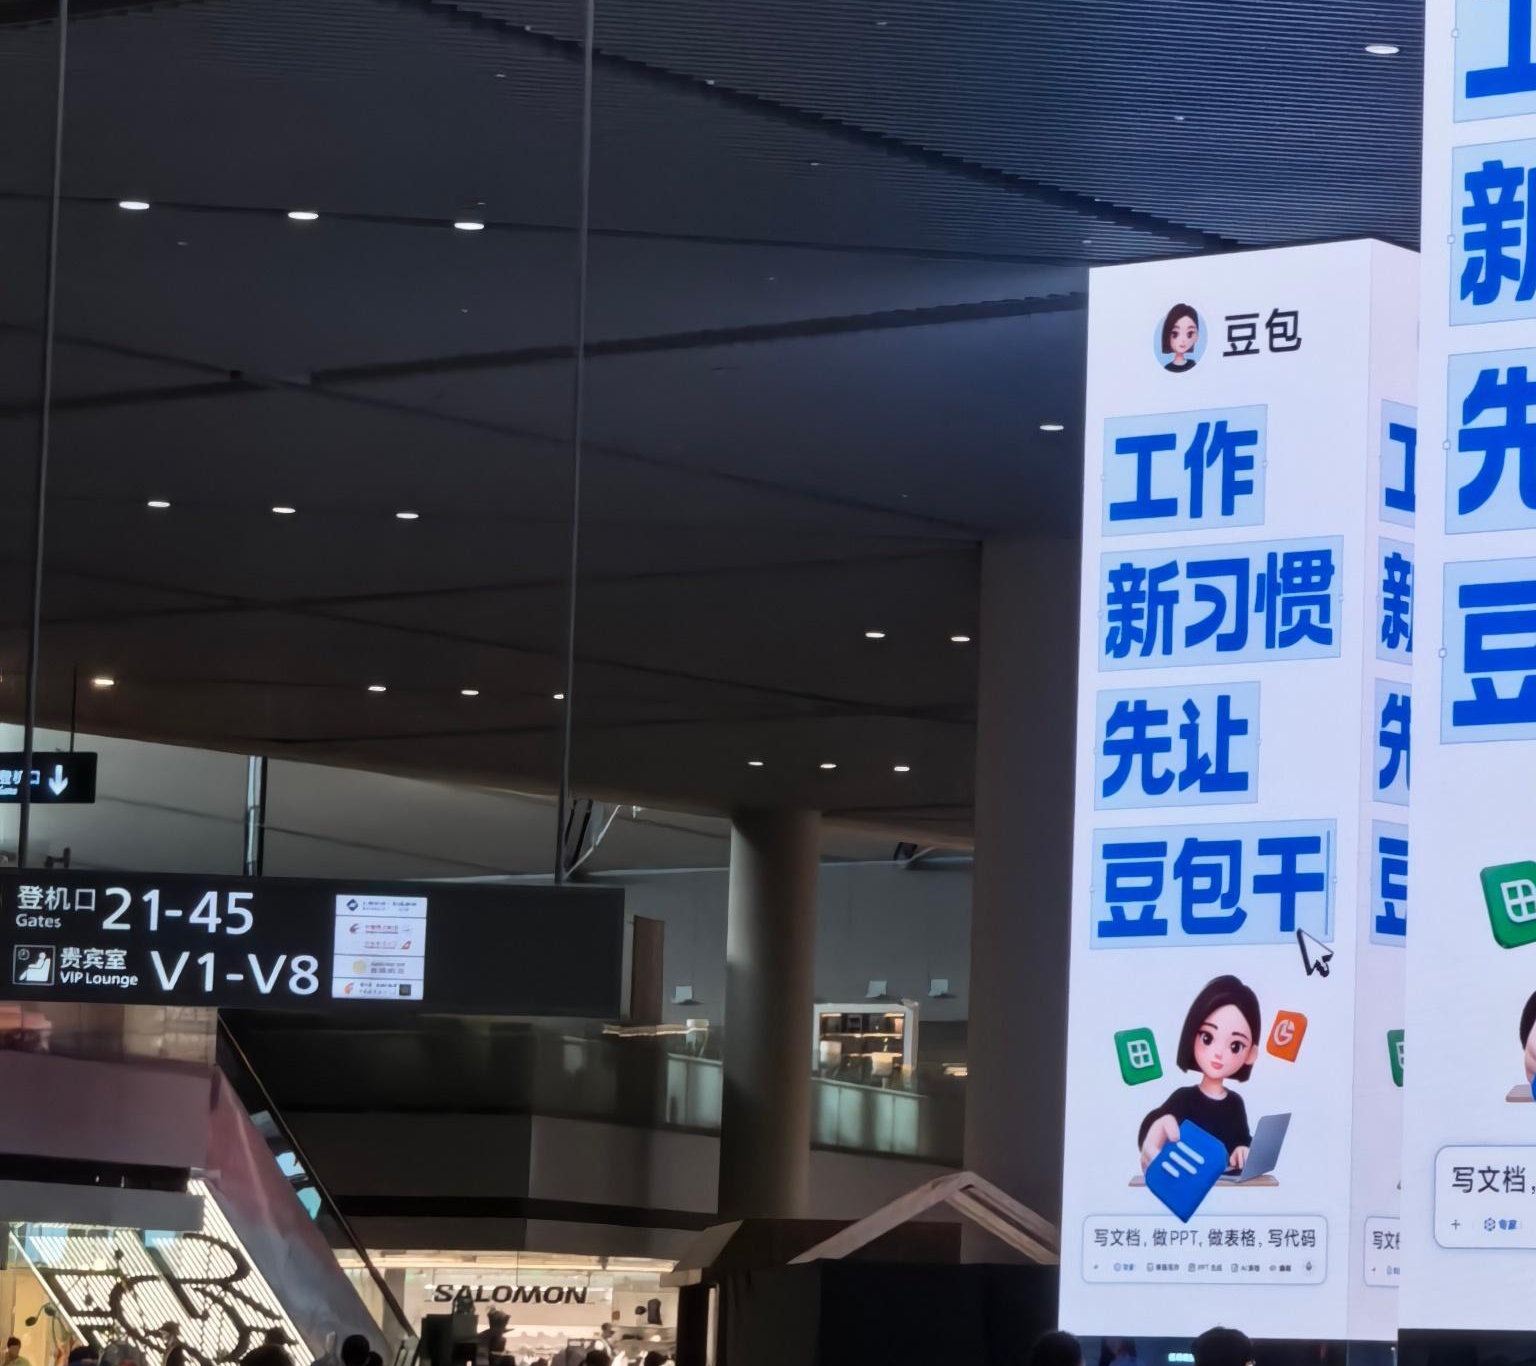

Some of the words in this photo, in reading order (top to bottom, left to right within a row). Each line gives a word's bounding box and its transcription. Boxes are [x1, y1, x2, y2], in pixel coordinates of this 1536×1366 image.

[1222, 308, 1302, 357] 豆包
[1109, 420, 1259, 522] 工作
[1105, 549, 1335, 659] 新习惯
[1102, 695, 1249, 798] 先让
[16, 885, 96, 912] 登机口
[102, 887, 254, 935] 21-45
[1097, 835, 1325, 939] 豆包干
[15, 912, 62, 929] Gates
[60, 946, 128, 971] 贵宾室
[150, 950, 319, 995] V1-V8
[60, 970, 84, 985] VIP
[85, 972, 139, 989] Lounge
[434, 1284, 588, 1304] SALOMON
